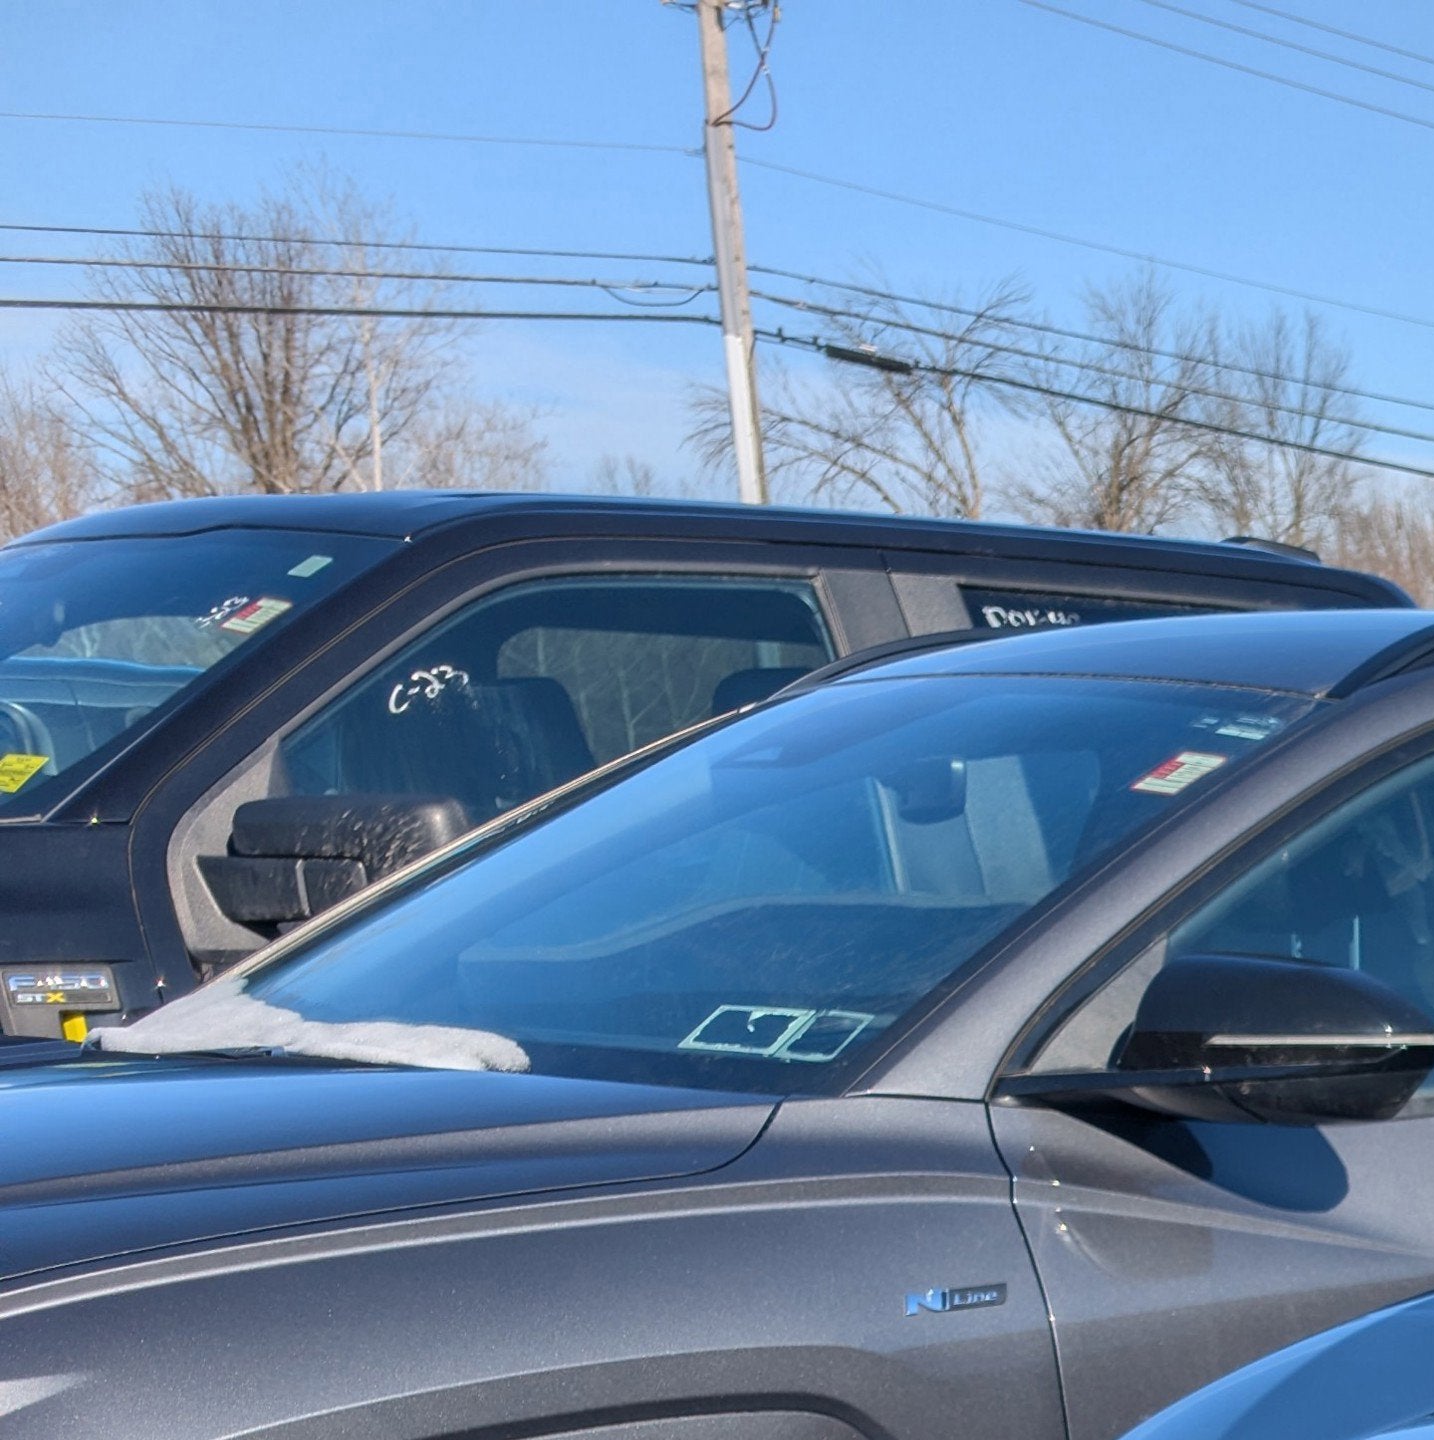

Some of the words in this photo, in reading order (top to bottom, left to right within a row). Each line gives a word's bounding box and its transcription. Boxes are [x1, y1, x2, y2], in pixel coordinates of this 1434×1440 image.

[17, 991, 67, 1003] STX
[905, 1286, 944, 1316] N
[953, 1290, 998, 1306] Line
